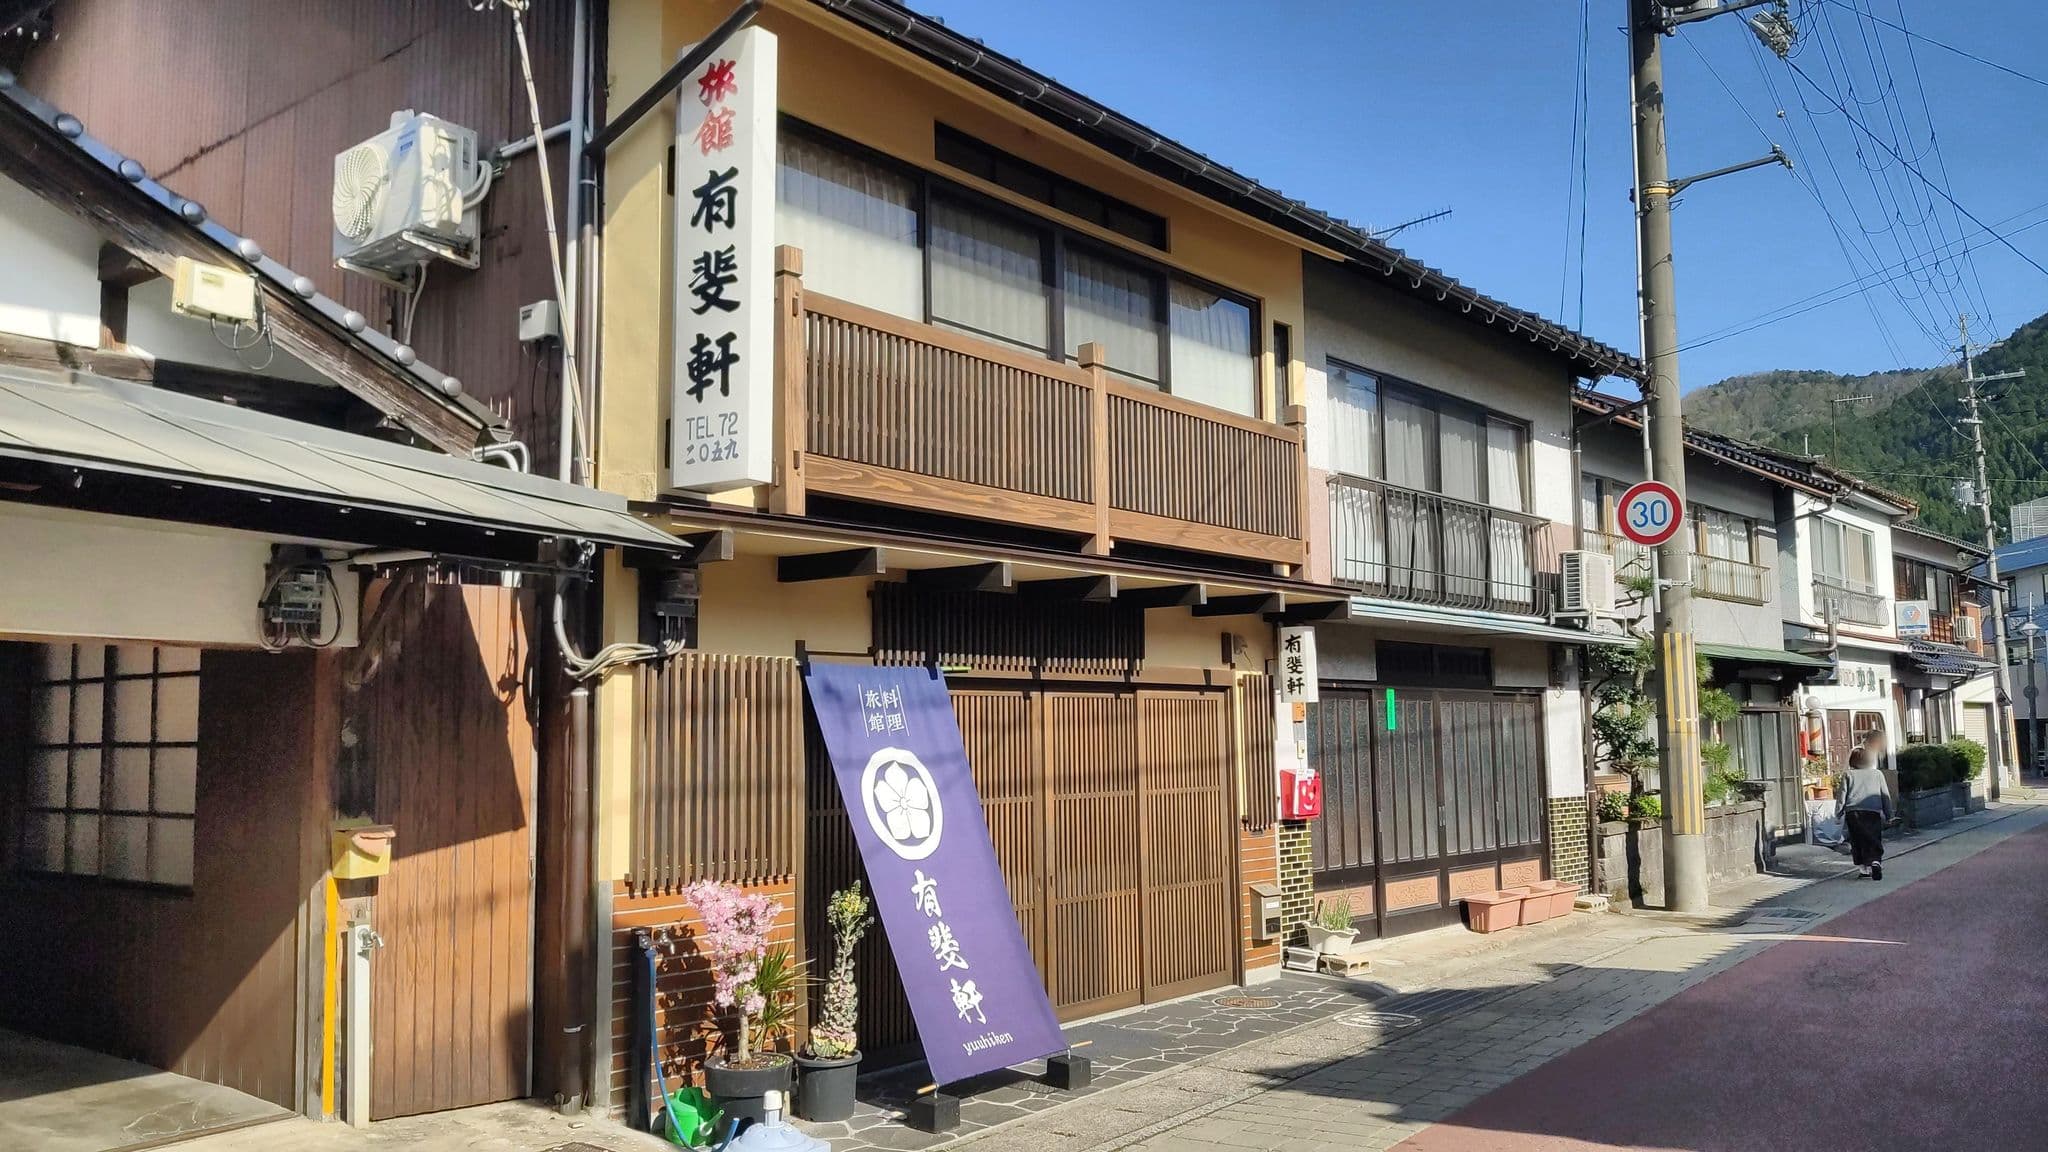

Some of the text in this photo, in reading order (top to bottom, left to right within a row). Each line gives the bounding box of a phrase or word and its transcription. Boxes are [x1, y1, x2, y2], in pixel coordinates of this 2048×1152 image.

[692, 58, 738, 157] 旅館
[686, 166, 741, 403] 有斐軒
[686, 411, 738, 440] TEL 72
[1632, 499, 1668, 528] 30
[1284, 633, 1305, 696] 有斐軒
[864, 689, 885, 733] 旅館
[882, 689, 905, 731] 料理
[911, 868, 987, 1025] 有斐軒
[962, 1031, 1014, 1056] yuuhiken
